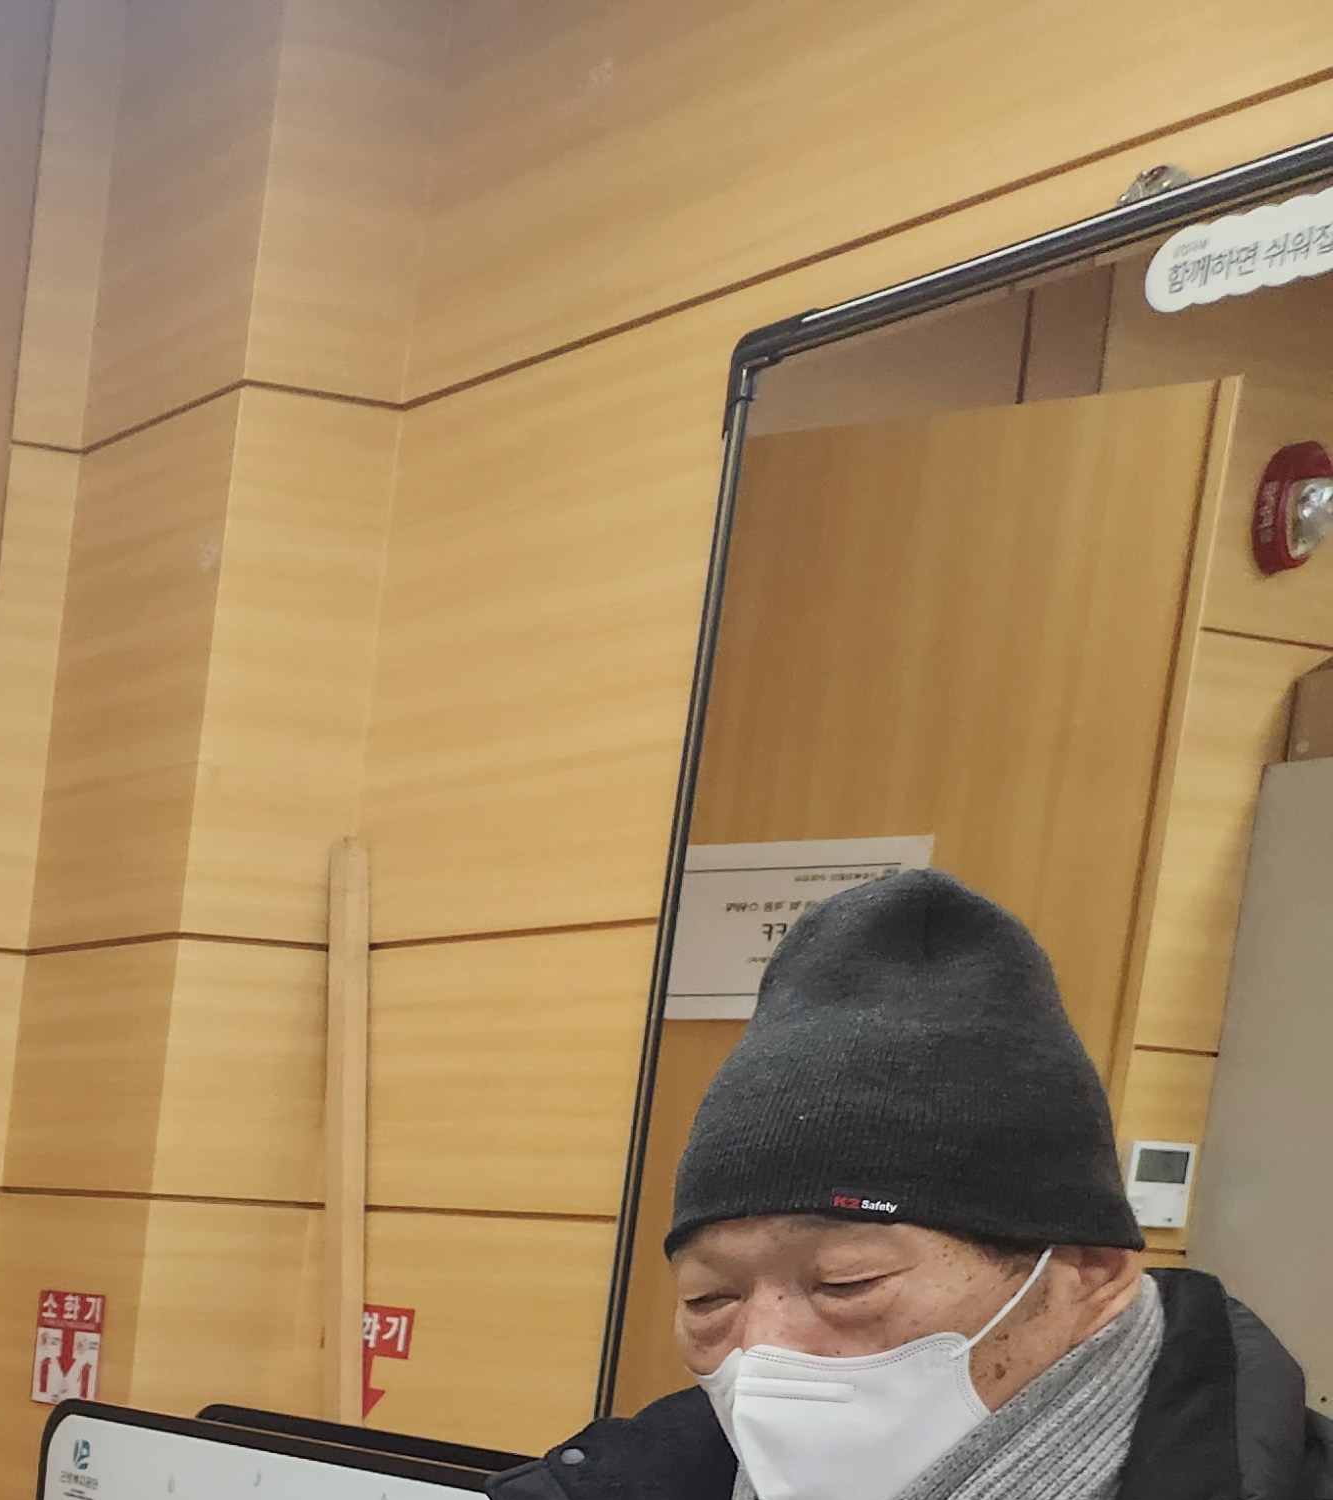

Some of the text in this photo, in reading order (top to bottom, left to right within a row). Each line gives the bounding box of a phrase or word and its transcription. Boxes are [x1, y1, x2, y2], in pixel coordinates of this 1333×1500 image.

[1167, 240, 1260, 295] 함께하면
[834, 1195, 899, 1214] K2 Safety
[41, 1293, 104, 1323] 소화기
